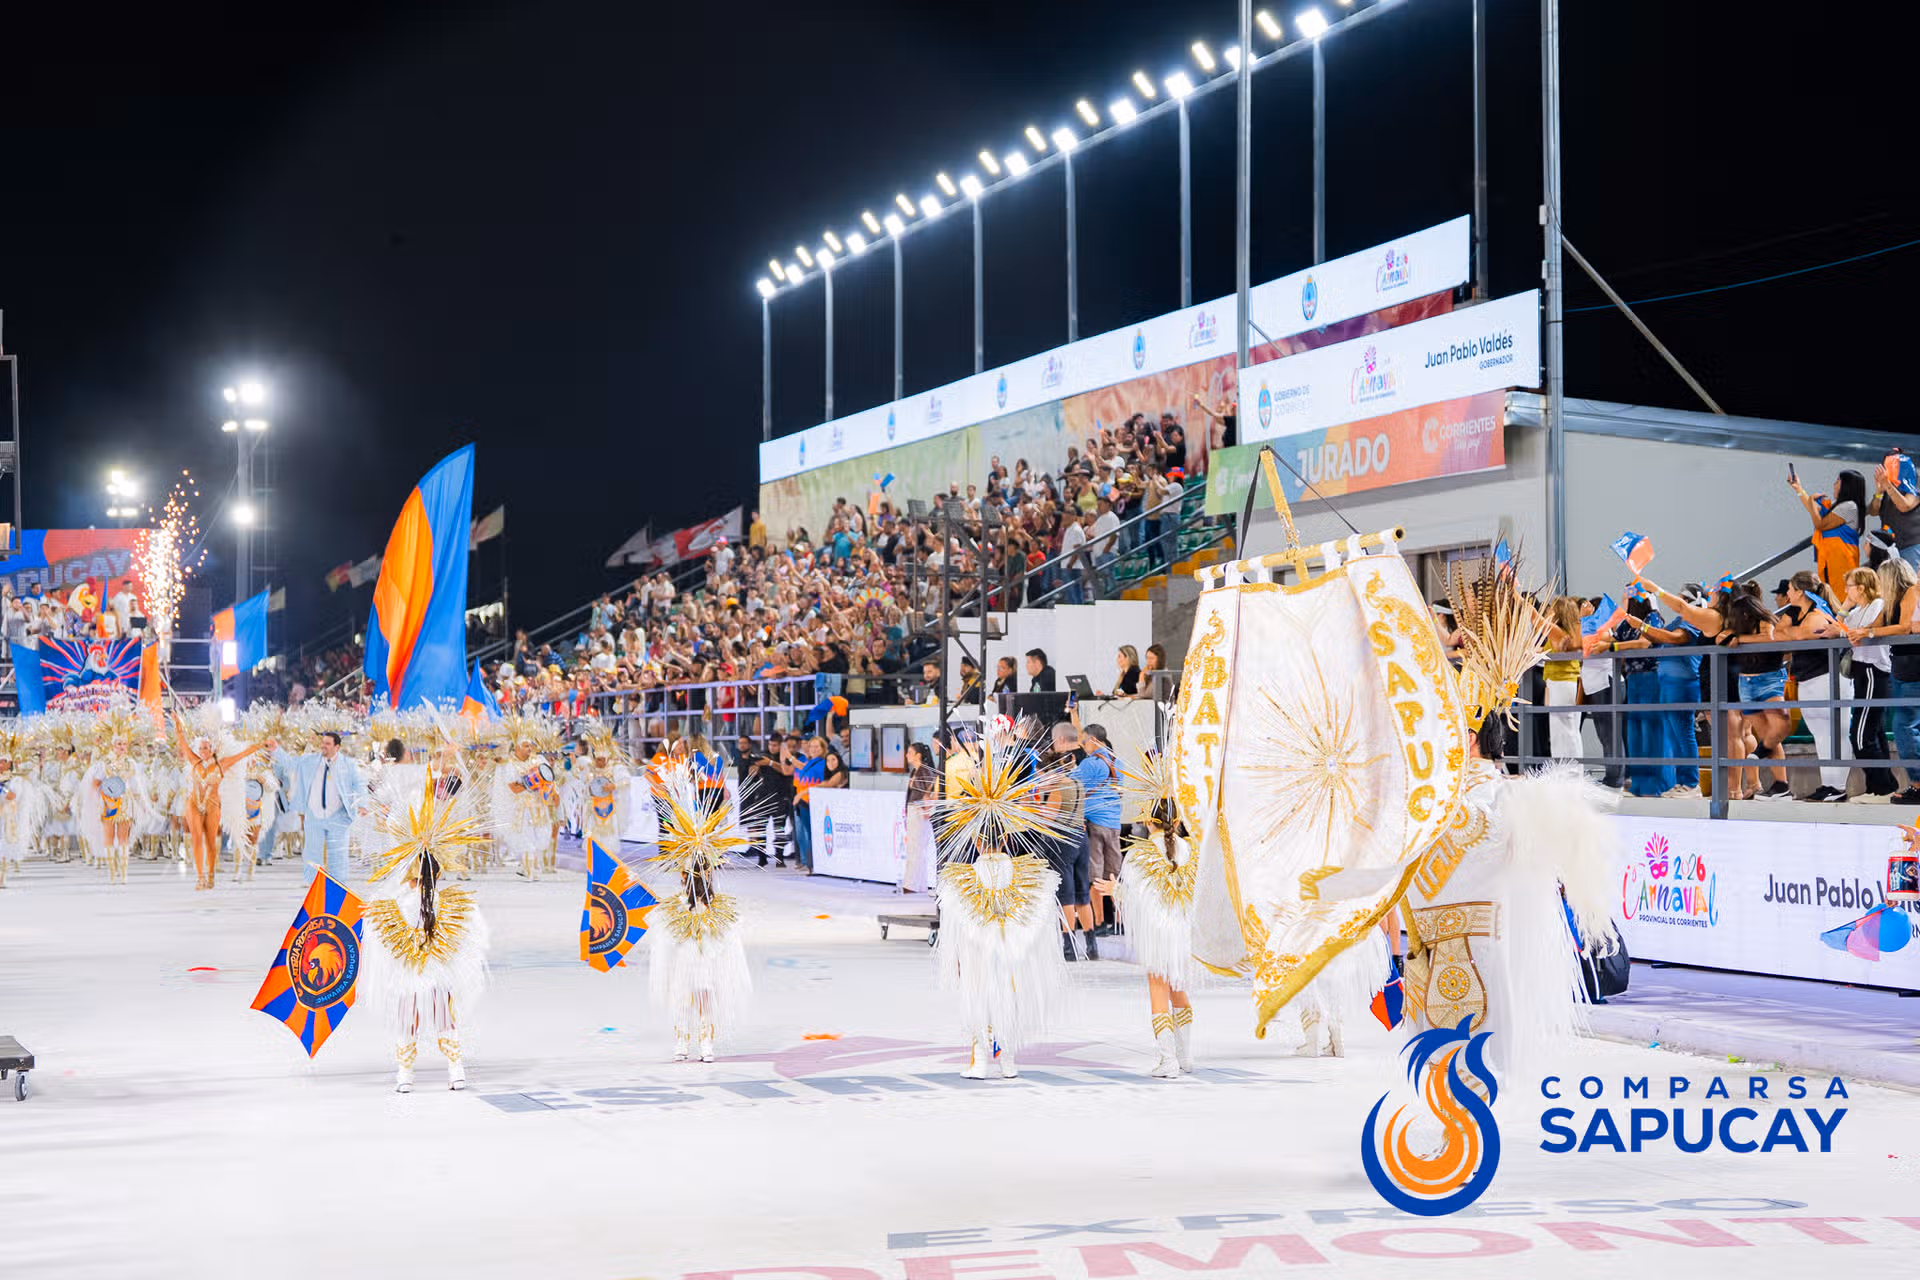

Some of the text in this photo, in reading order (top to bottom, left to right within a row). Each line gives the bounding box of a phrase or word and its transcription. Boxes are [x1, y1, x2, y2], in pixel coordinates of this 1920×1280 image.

[1425, 329, 1513, 368] Juan Pablo Valdés
[1479, 354, 1513, 369] GOBERNADOR
[1440, 416, 1496, 439] CORRIENTES
[1295, 433, 1390, 487] JURADO
[1674, 853, 1706, 882] 2026
[1764, 873, 1811, 905] Juan
[1816, 877, 1874, 909] Pablo
[1639, 914, 1708, 928] PROVINCIAL DE CORRIENTES
